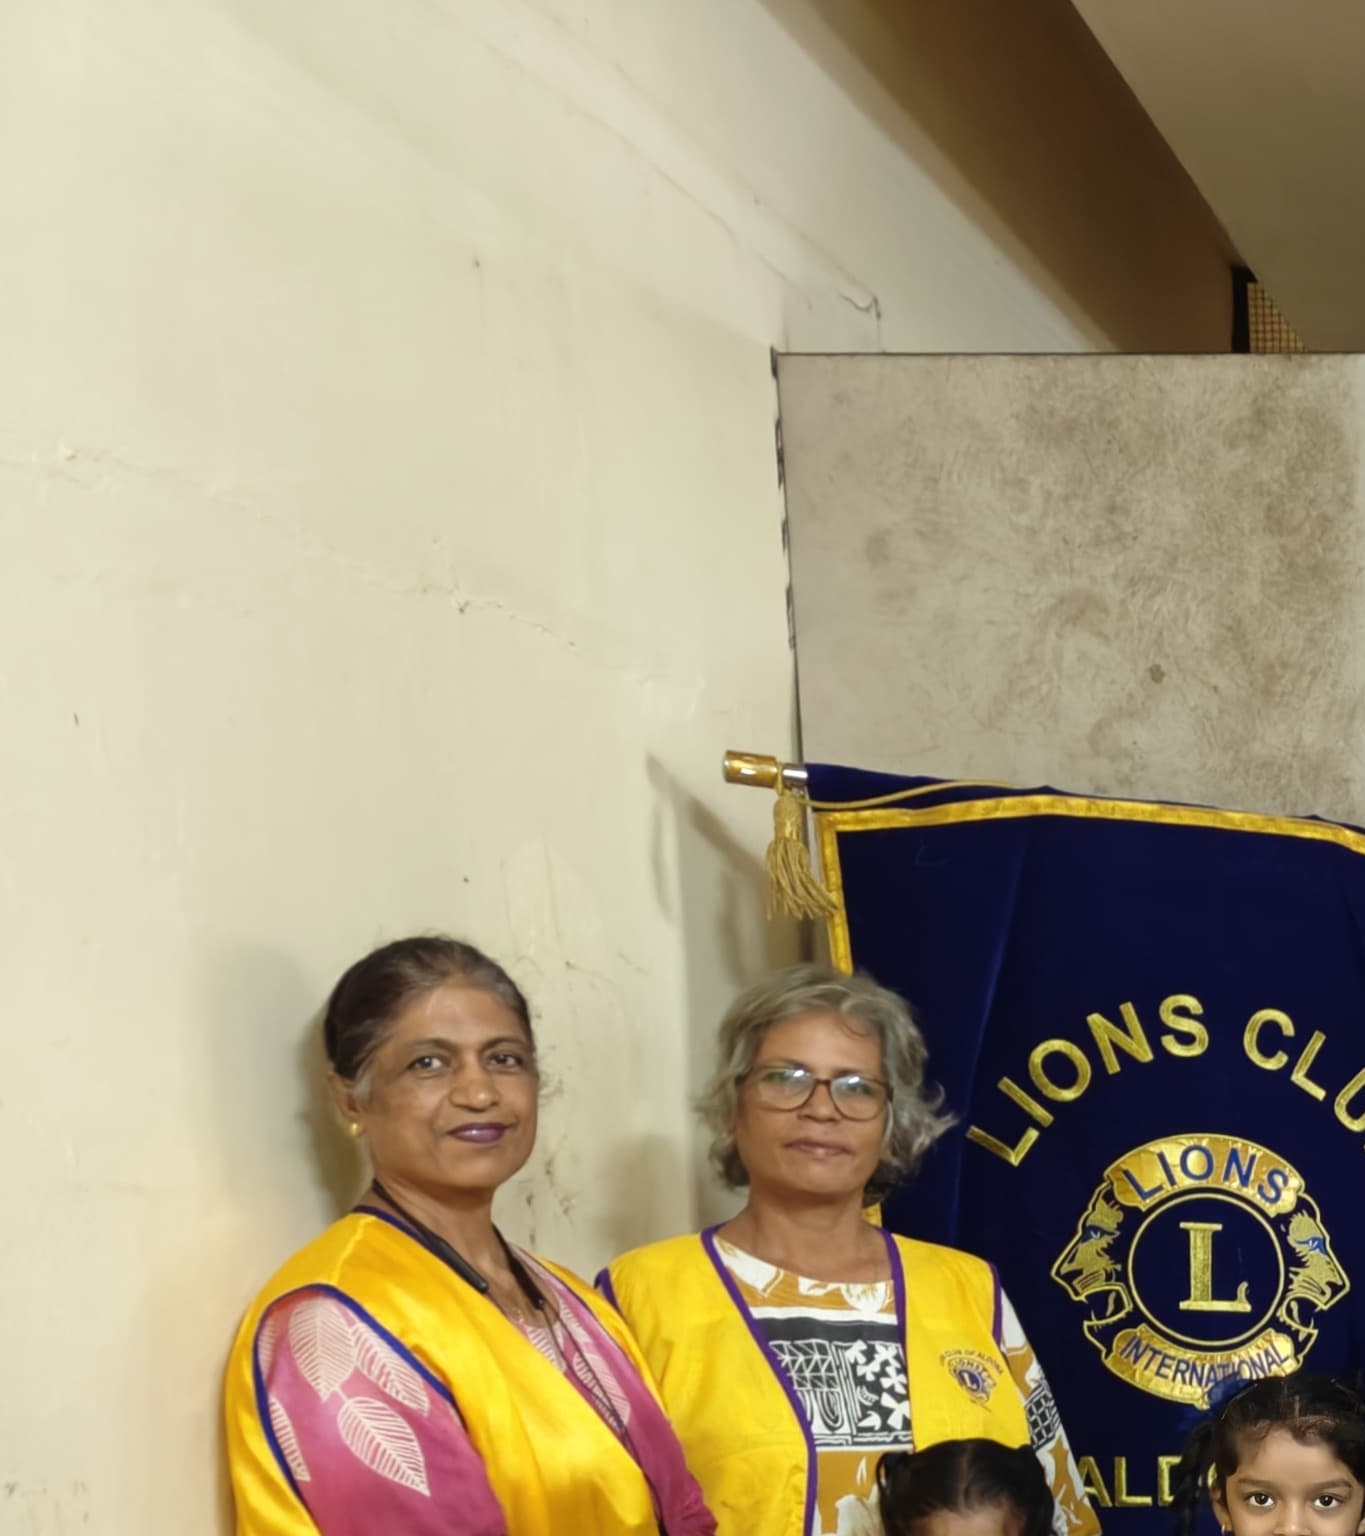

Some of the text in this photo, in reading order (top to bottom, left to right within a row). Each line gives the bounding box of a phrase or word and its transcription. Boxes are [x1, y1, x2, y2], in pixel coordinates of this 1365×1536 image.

[966, 994, 1209, 1167] LIONS
[1122, 1145, 1288, 1204] LIONS
[1179, 1221, 1252, 1313] L
